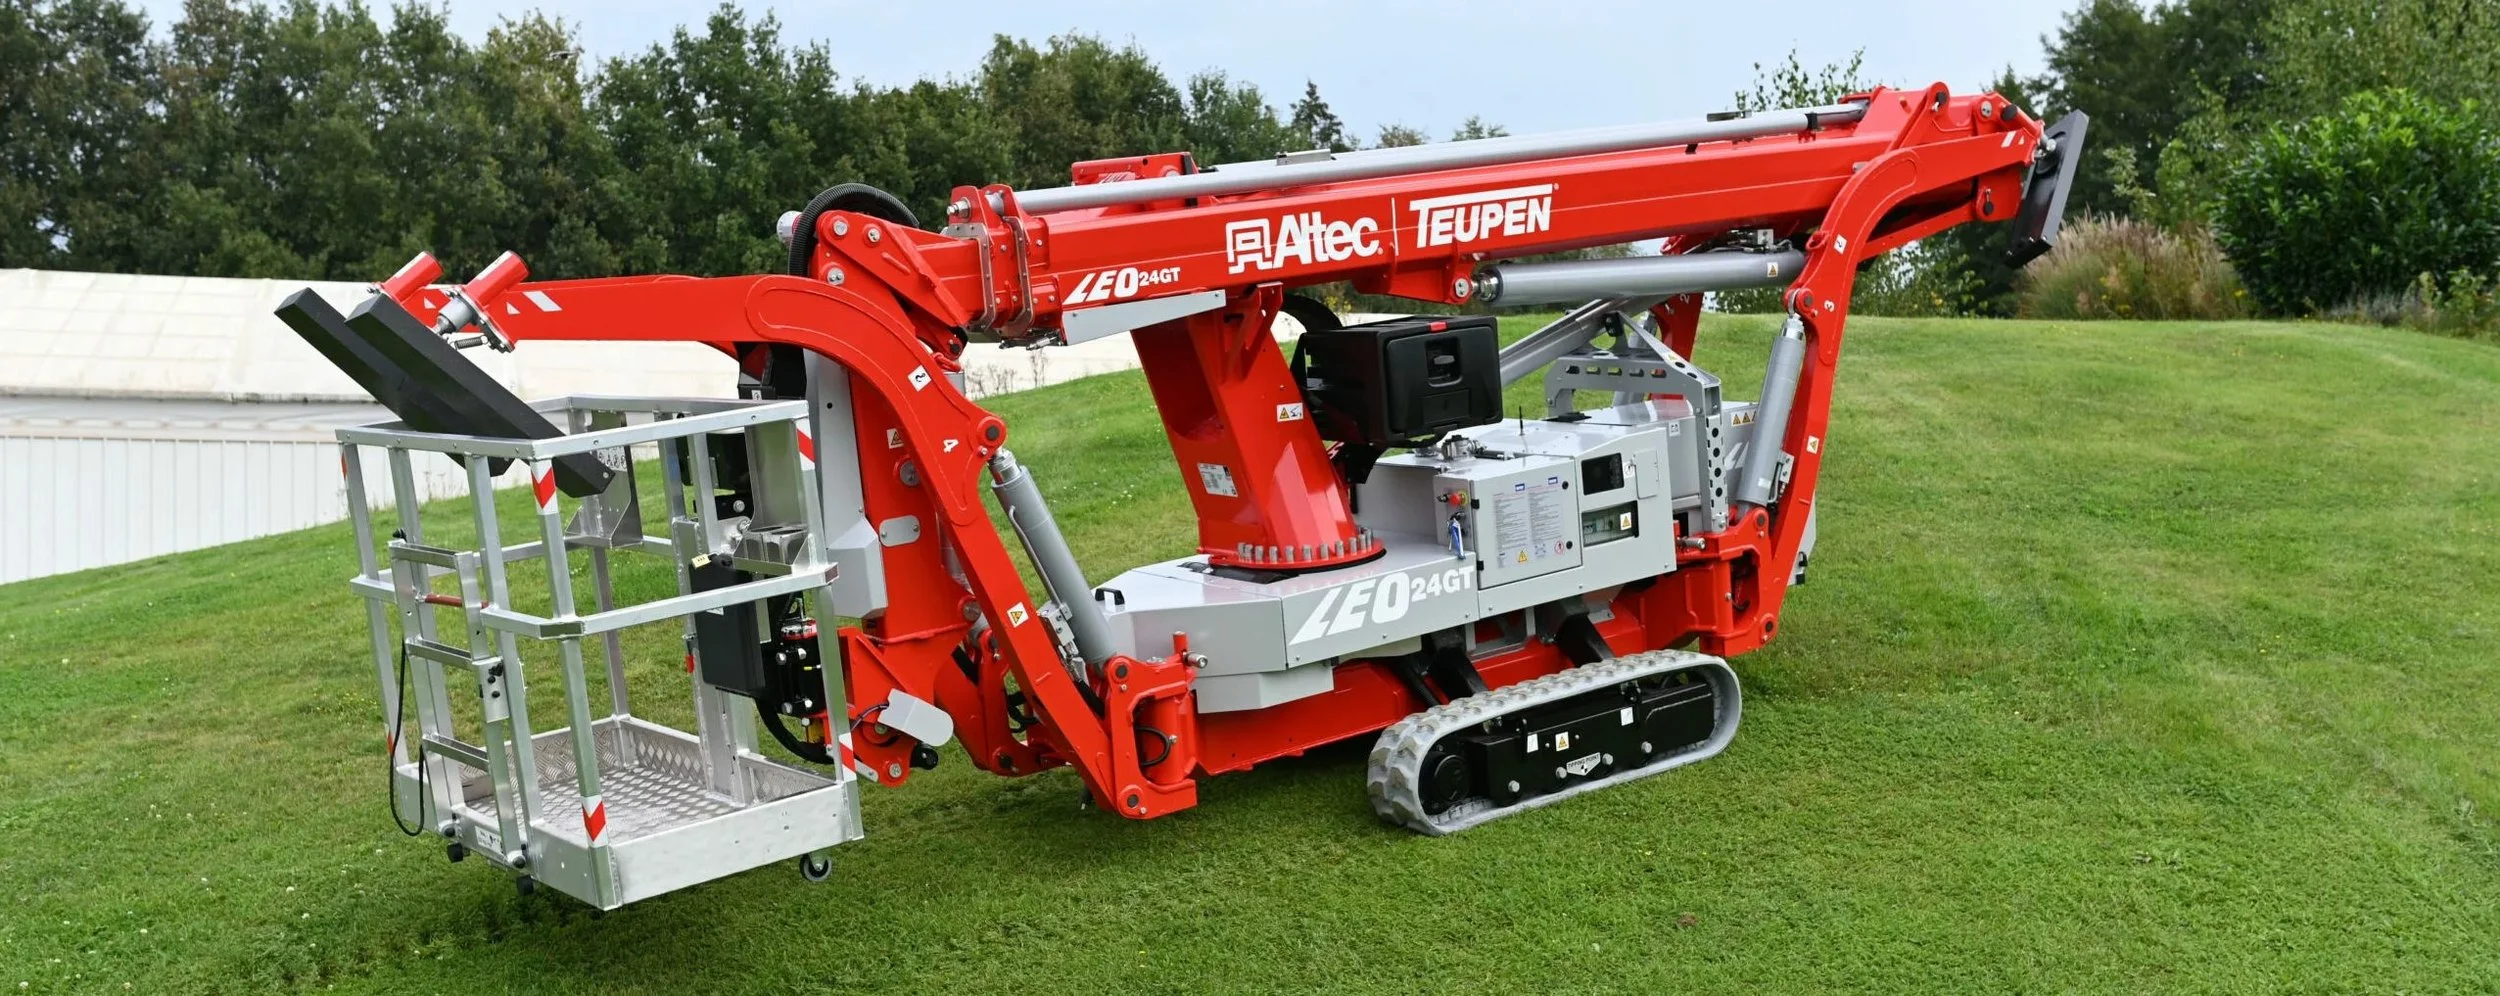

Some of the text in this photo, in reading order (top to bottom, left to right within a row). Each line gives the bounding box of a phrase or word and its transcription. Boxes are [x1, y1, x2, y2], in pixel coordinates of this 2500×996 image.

[1272, 211, 1379, 269] Altec
[1409, 184, 1553, 248] TEUPEN
[1062, 267, 1138, 305] LEO
[1824, 300, 1835, 312] 3
[943, 439, 959, 453] 4
[1289, 565, 1474, 646] LEO 24GT
